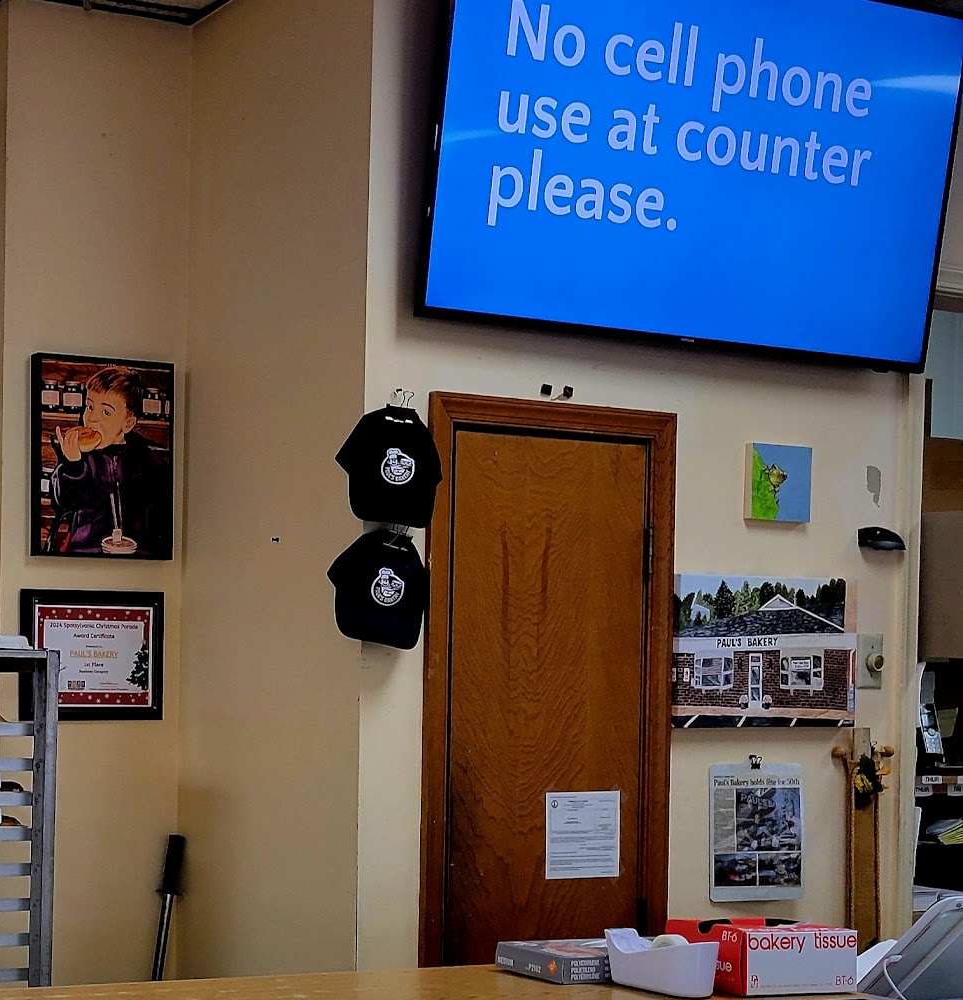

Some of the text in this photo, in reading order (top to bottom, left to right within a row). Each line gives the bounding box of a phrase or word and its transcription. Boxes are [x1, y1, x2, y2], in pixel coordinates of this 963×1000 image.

[506, 0, 873, 117] No cell phone
[497, 89, 872, 187] use at counter
[487, 149, 677, 231] please.
[716, 637, 779, 648] PAUL'S BAKERY
[93, 651, 118, 659] BAKERY
[721, 930, 738, 943] BT-6
[747, 932, 857, 953] bakery tissue
[835, 975, 854, 986] BT-6
